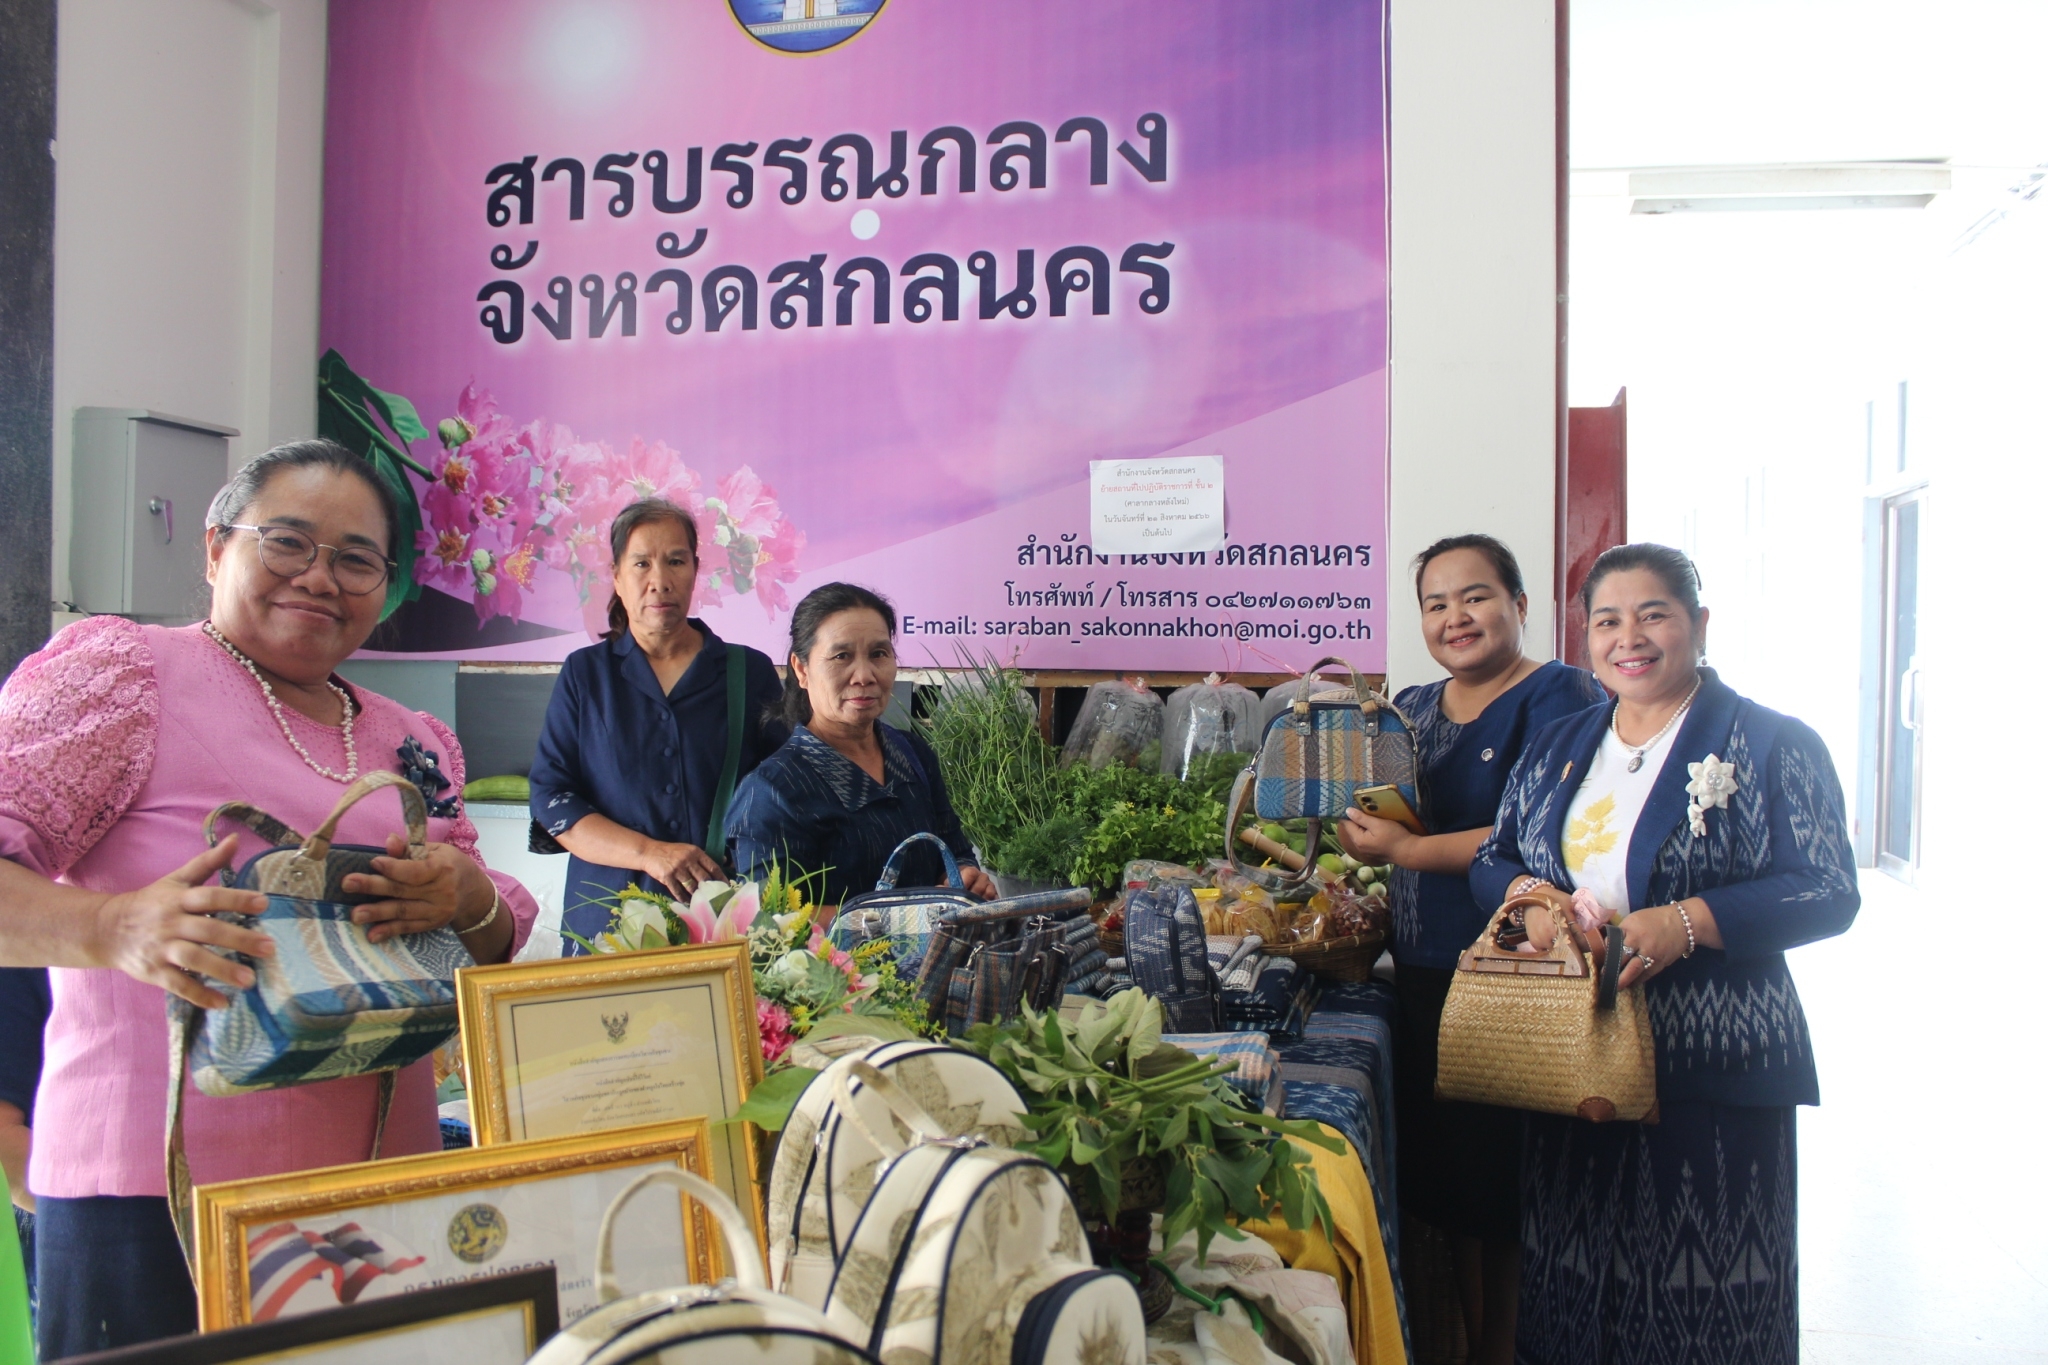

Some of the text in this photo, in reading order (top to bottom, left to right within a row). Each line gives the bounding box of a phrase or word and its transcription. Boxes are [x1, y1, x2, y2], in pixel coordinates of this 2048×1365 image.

[484, 111, 1168, 229] สารบรรณกลาง
[475, 227, 1176, 345] จังหวัดสกลนคร
[903, 616, 1371, 645] E-mail: saraban_sakonnakhon@moi.go.th
[1004, 581, 1095, 607] โทรศัพท์
[1116, 581, 1198, 608] โทรสาร
[1205, 591, 1371, 609] ๐๔๒๗๑๑๗๖๓
